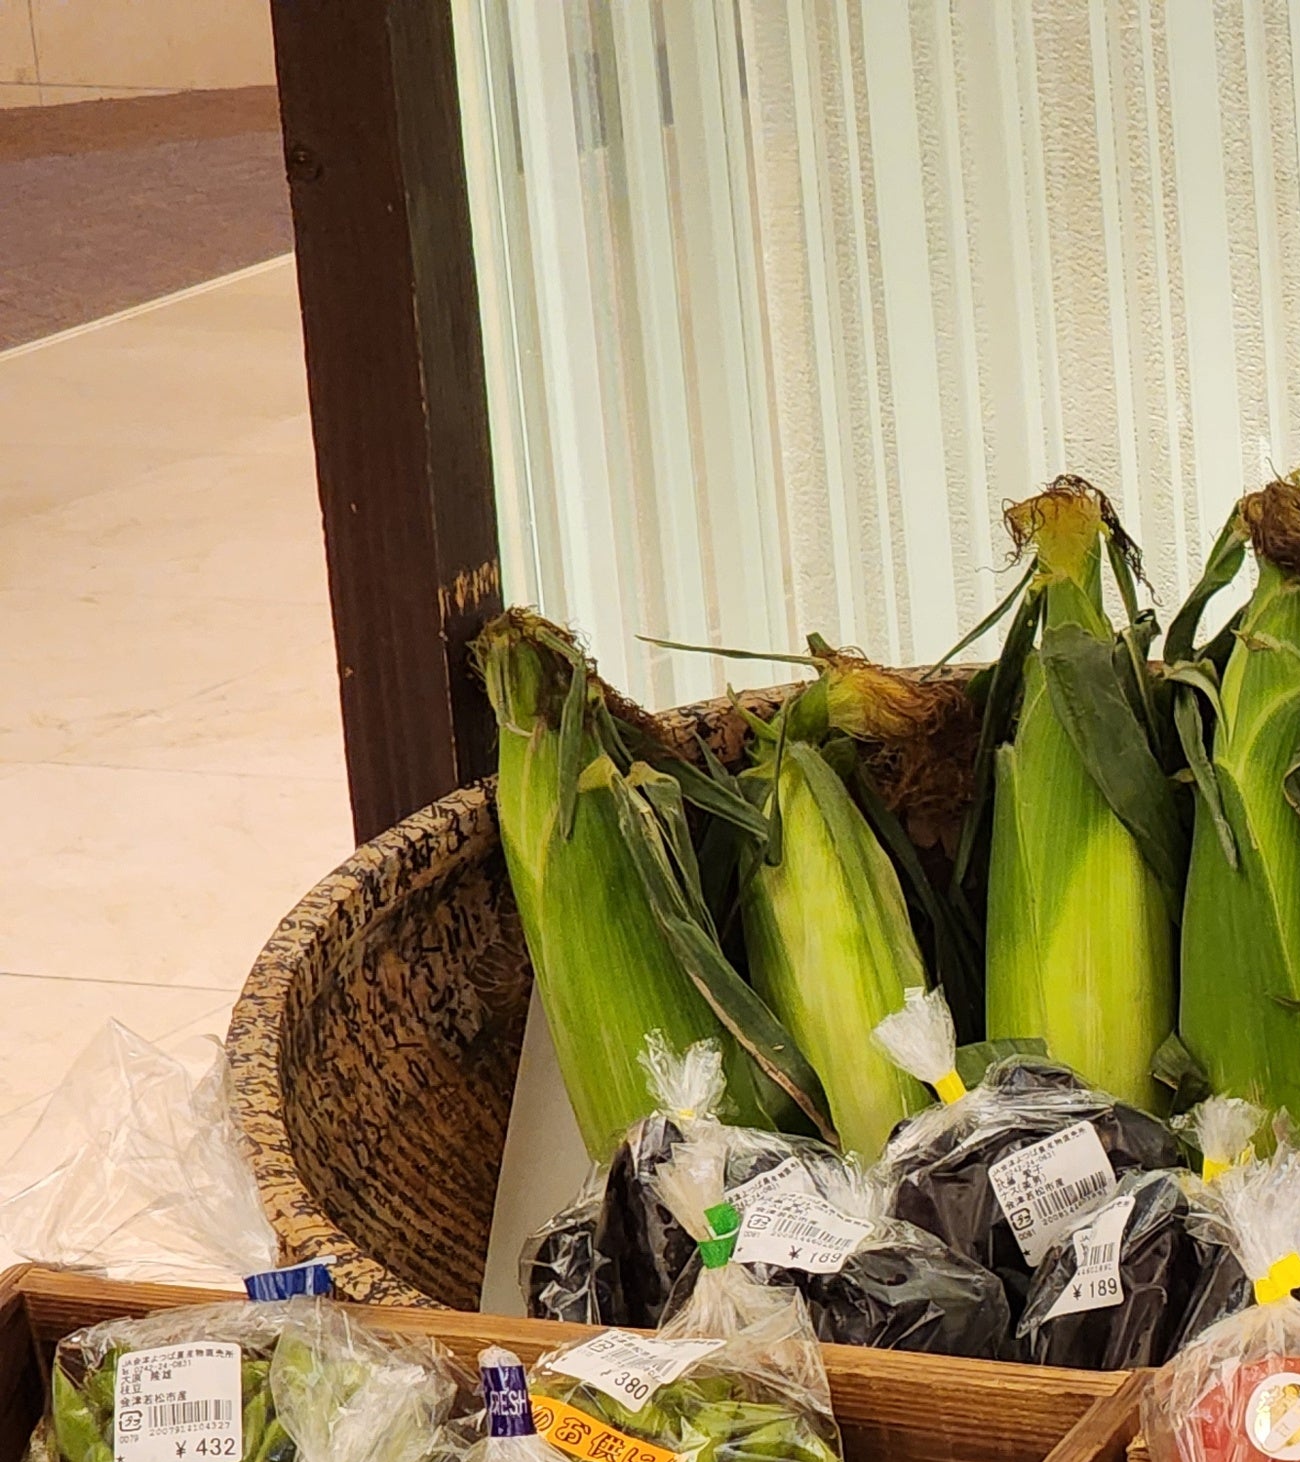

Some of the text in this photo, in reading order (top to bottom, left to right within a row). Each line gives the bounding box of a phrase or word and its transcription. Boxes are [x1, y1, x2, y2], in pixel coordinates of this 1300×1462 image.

[1005, 1178, 1064, 1210] 会津若松市産
[788, 1245, 842, 1264] ¥ 189
[1073, 1277, 1118, 1300] ¥ 189
[614, 1371, 650, 1400] 380
[120, 1391, 187, 1408] 会津若松市産
[175, 1437, 237, 1459] ¥ 432
